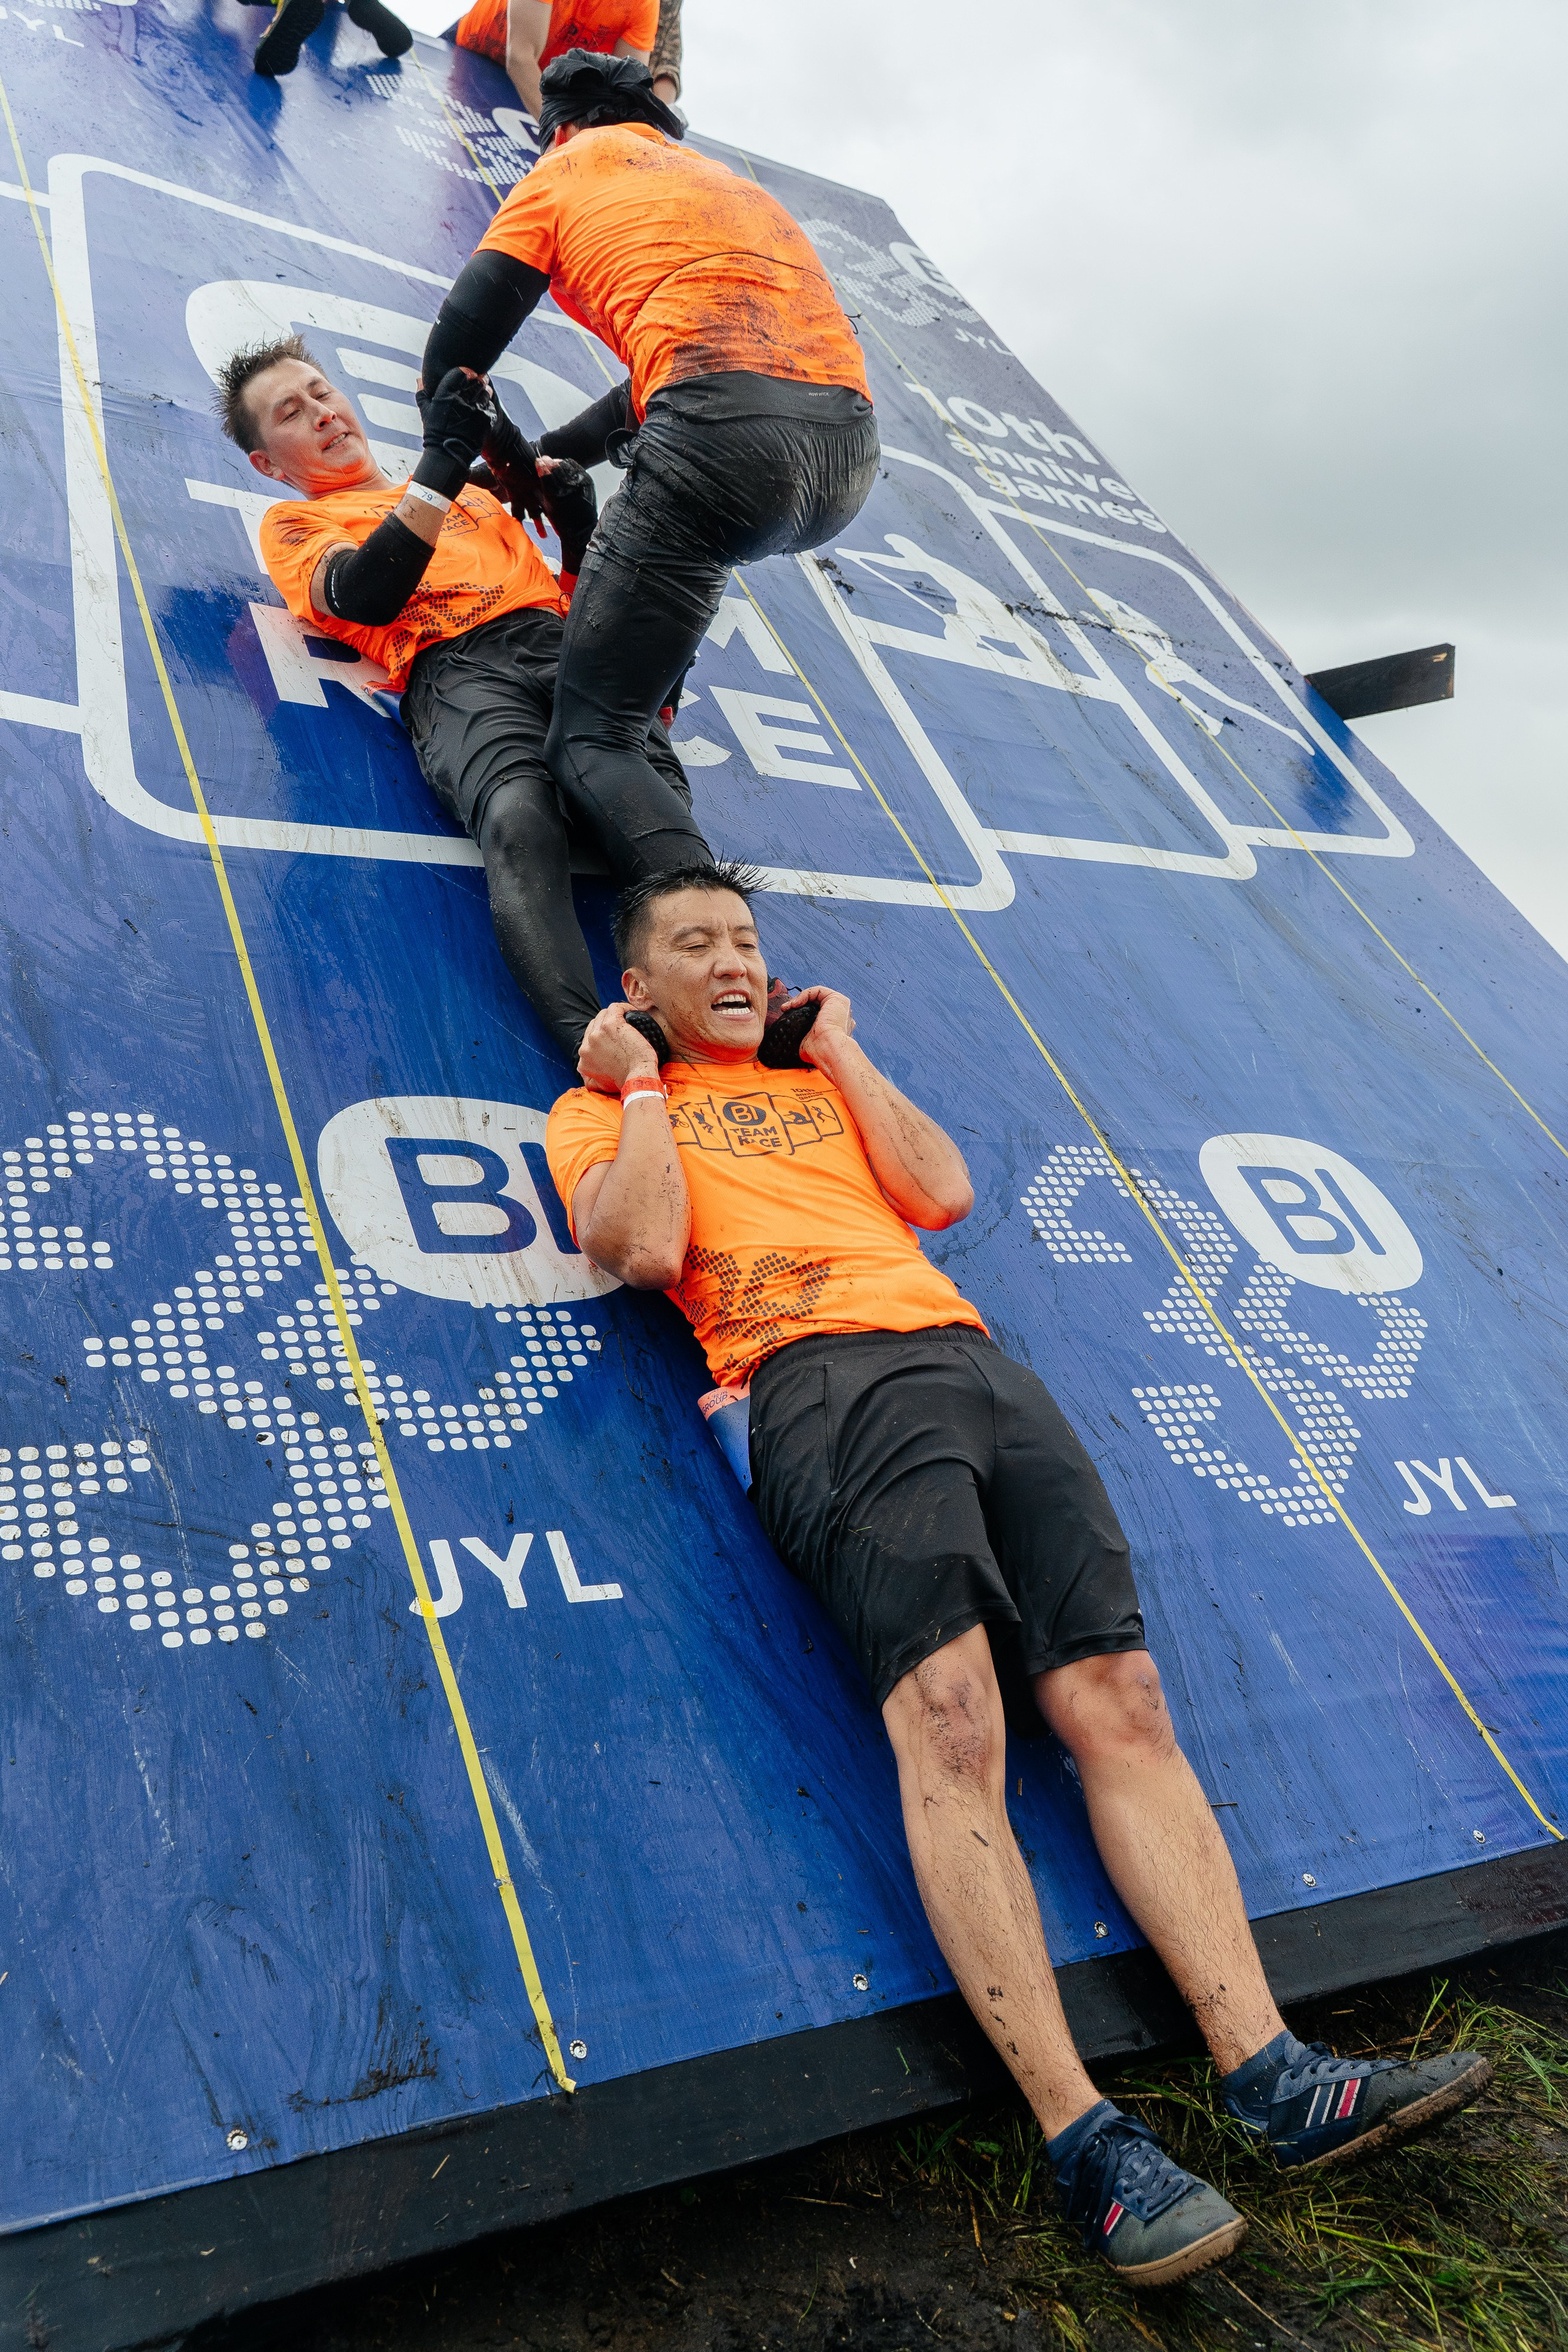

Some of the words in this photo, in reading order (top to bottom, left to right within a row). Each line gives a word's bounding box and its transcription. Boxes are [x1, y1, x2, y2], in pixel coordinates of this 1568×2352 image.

[903, 382, 1100, 466] 10th
[974, 466, 1167, 533] games
[729, 1126, 778, 1137] TEAM
[730, 1105, 759, 1122] BI
[1237, 1166, 1387, 1256] BI
[1394, 1457, 1517, 1516] JYL
[409, 1530, 624, 1619] JYL
